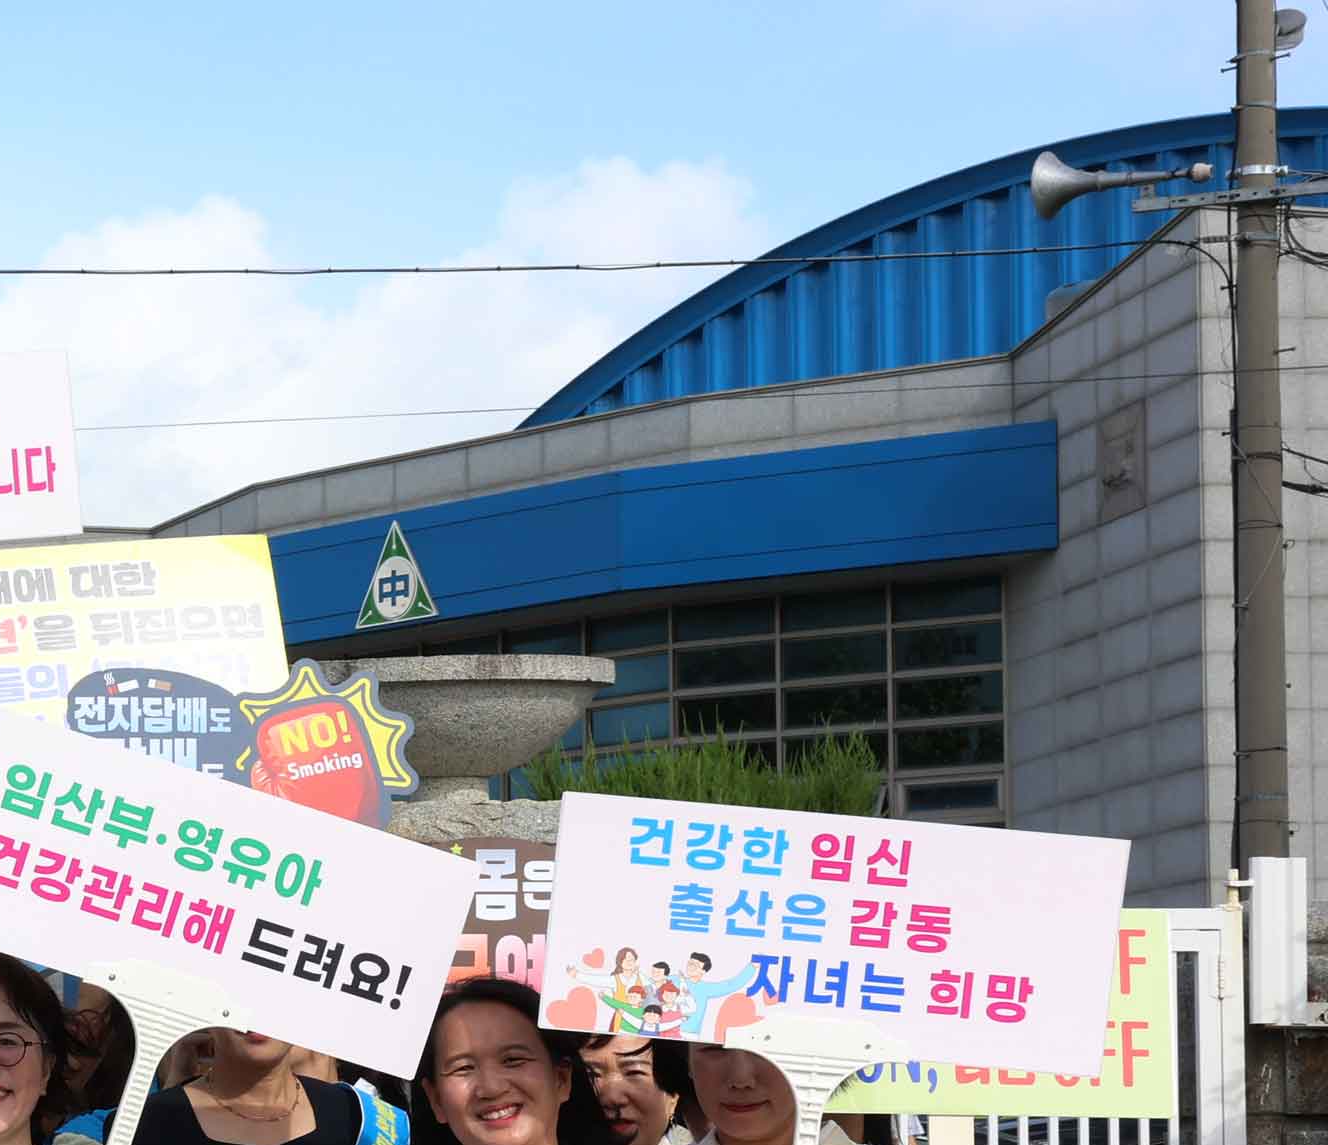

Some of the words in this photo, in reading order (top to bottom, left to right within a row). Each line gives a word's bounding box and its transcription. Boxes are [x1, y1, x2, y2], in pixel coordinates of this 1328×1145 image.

[68, 562, 157, 599] 대한
[379, 569, 410, 607] 中
[89, 604, 265, 647] 뒤집으면
[74, 696, 232, 734] 전자담배도
[280, 711, 353, 755] NO!
[287, 751, 363, 781] Smoking
[0, 764, 324, 907] 임산부·영유아
[628, 816, 790, 877] 건강한
[810, 832, 914, 889] 임신
[667, 882, 829, 944] 출산은
[849, 898, 953, 954] 감동
[241, 918, 413, 1011] 드려요!
[744, 953, 906, 1014] 자녀는
[926, 970, 1035, 1025] 희망
